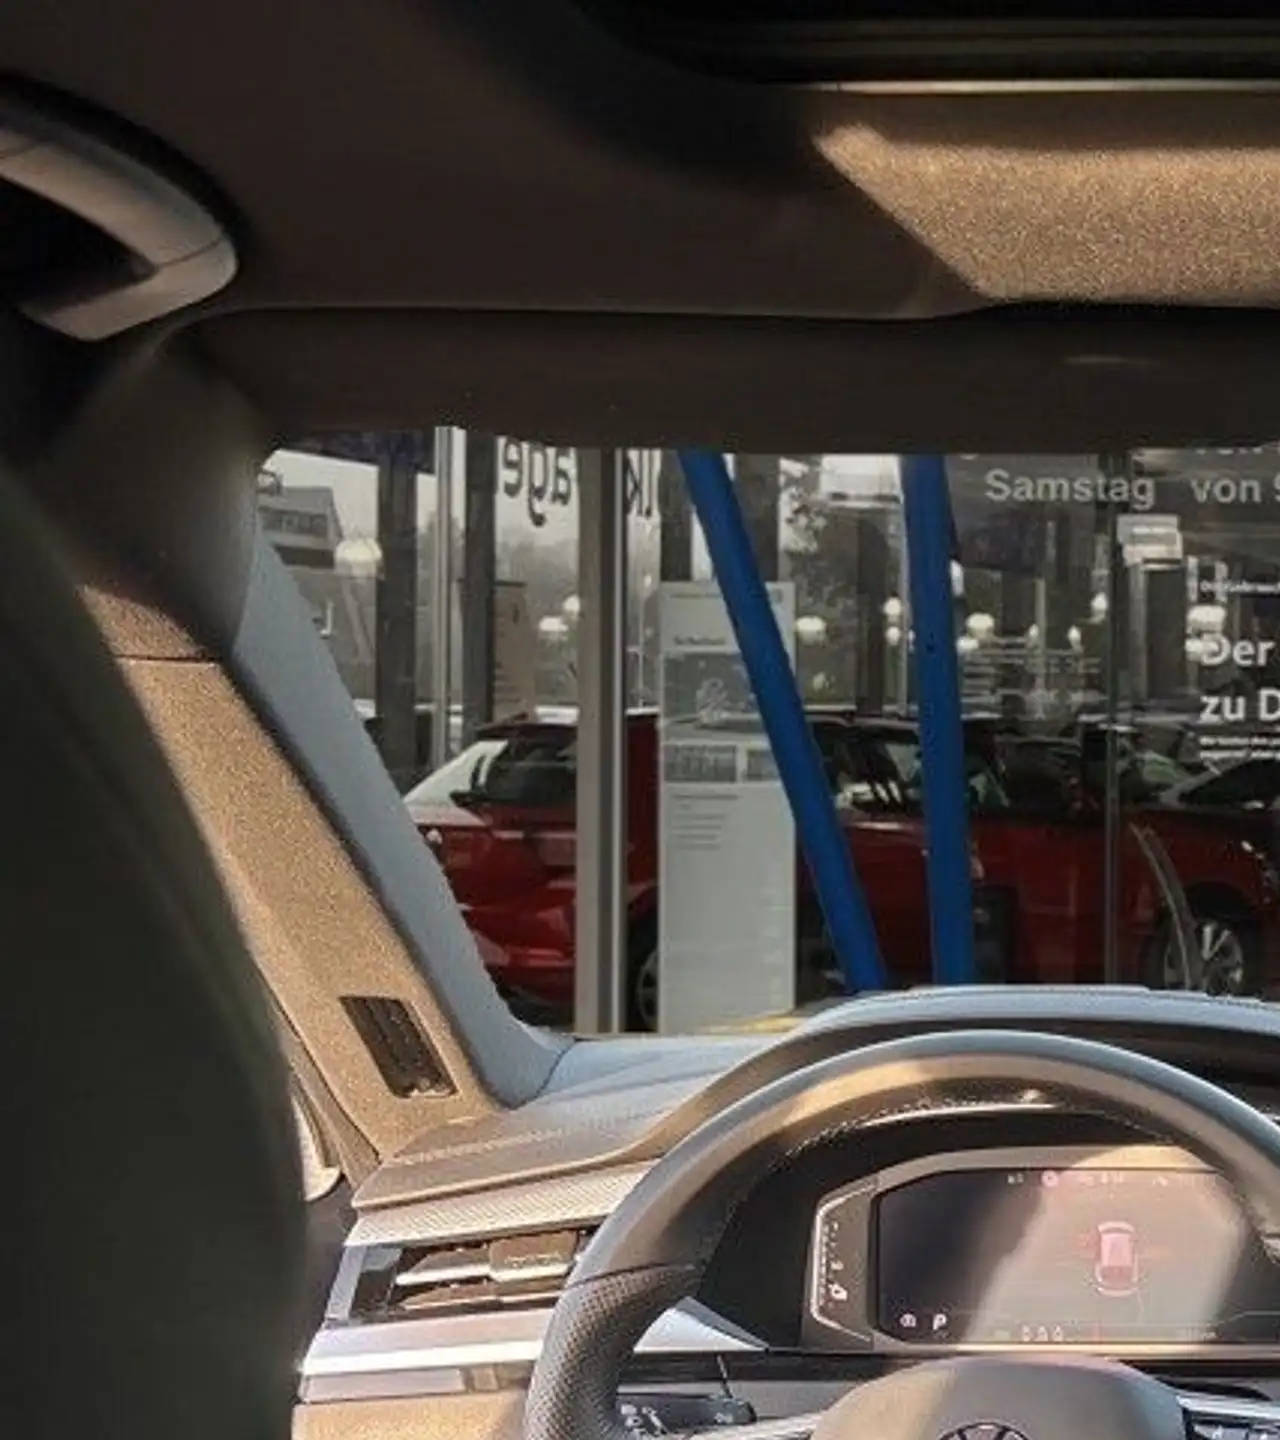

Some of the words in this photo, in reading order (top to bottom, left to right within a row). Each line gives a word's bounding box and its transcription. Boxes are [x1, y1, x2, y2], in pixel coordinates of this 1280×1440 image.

[985, 468, 1155, 510] Samstag
[1190, 477, 1262, 503] von
[1201, 633, 1276, 667] Der
[1201, 696, 1247, 722] zu
